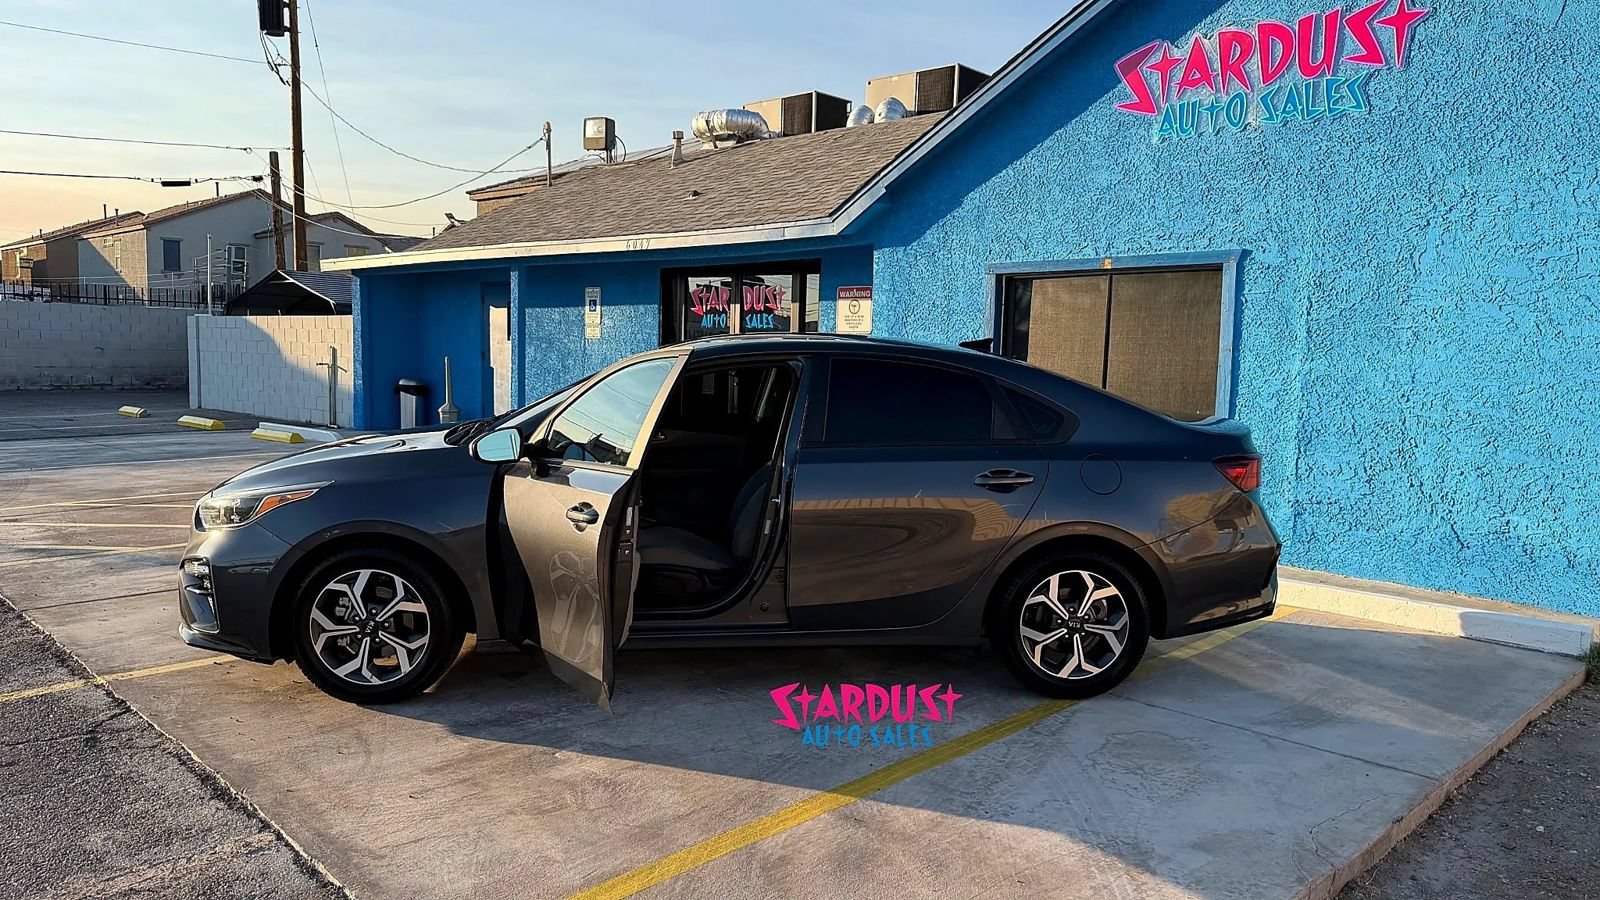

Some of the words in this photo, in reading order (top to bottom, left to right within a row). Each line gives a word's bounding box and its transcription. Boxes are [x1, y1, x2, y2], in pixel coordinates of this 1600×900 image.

[1114, 0, 1428, 116] STARDUST
[1154, 91, 1246, 138] AUTO
[1257, 71, 1367, 124] SALES
[690, 286, 730, 316] STAR
[743, 284, 786, 311] DUST
[840, 290, 871, 298] WARNING
[701, 313, 727, 329] AUTO
[745, 313, 774, 329] SALES
